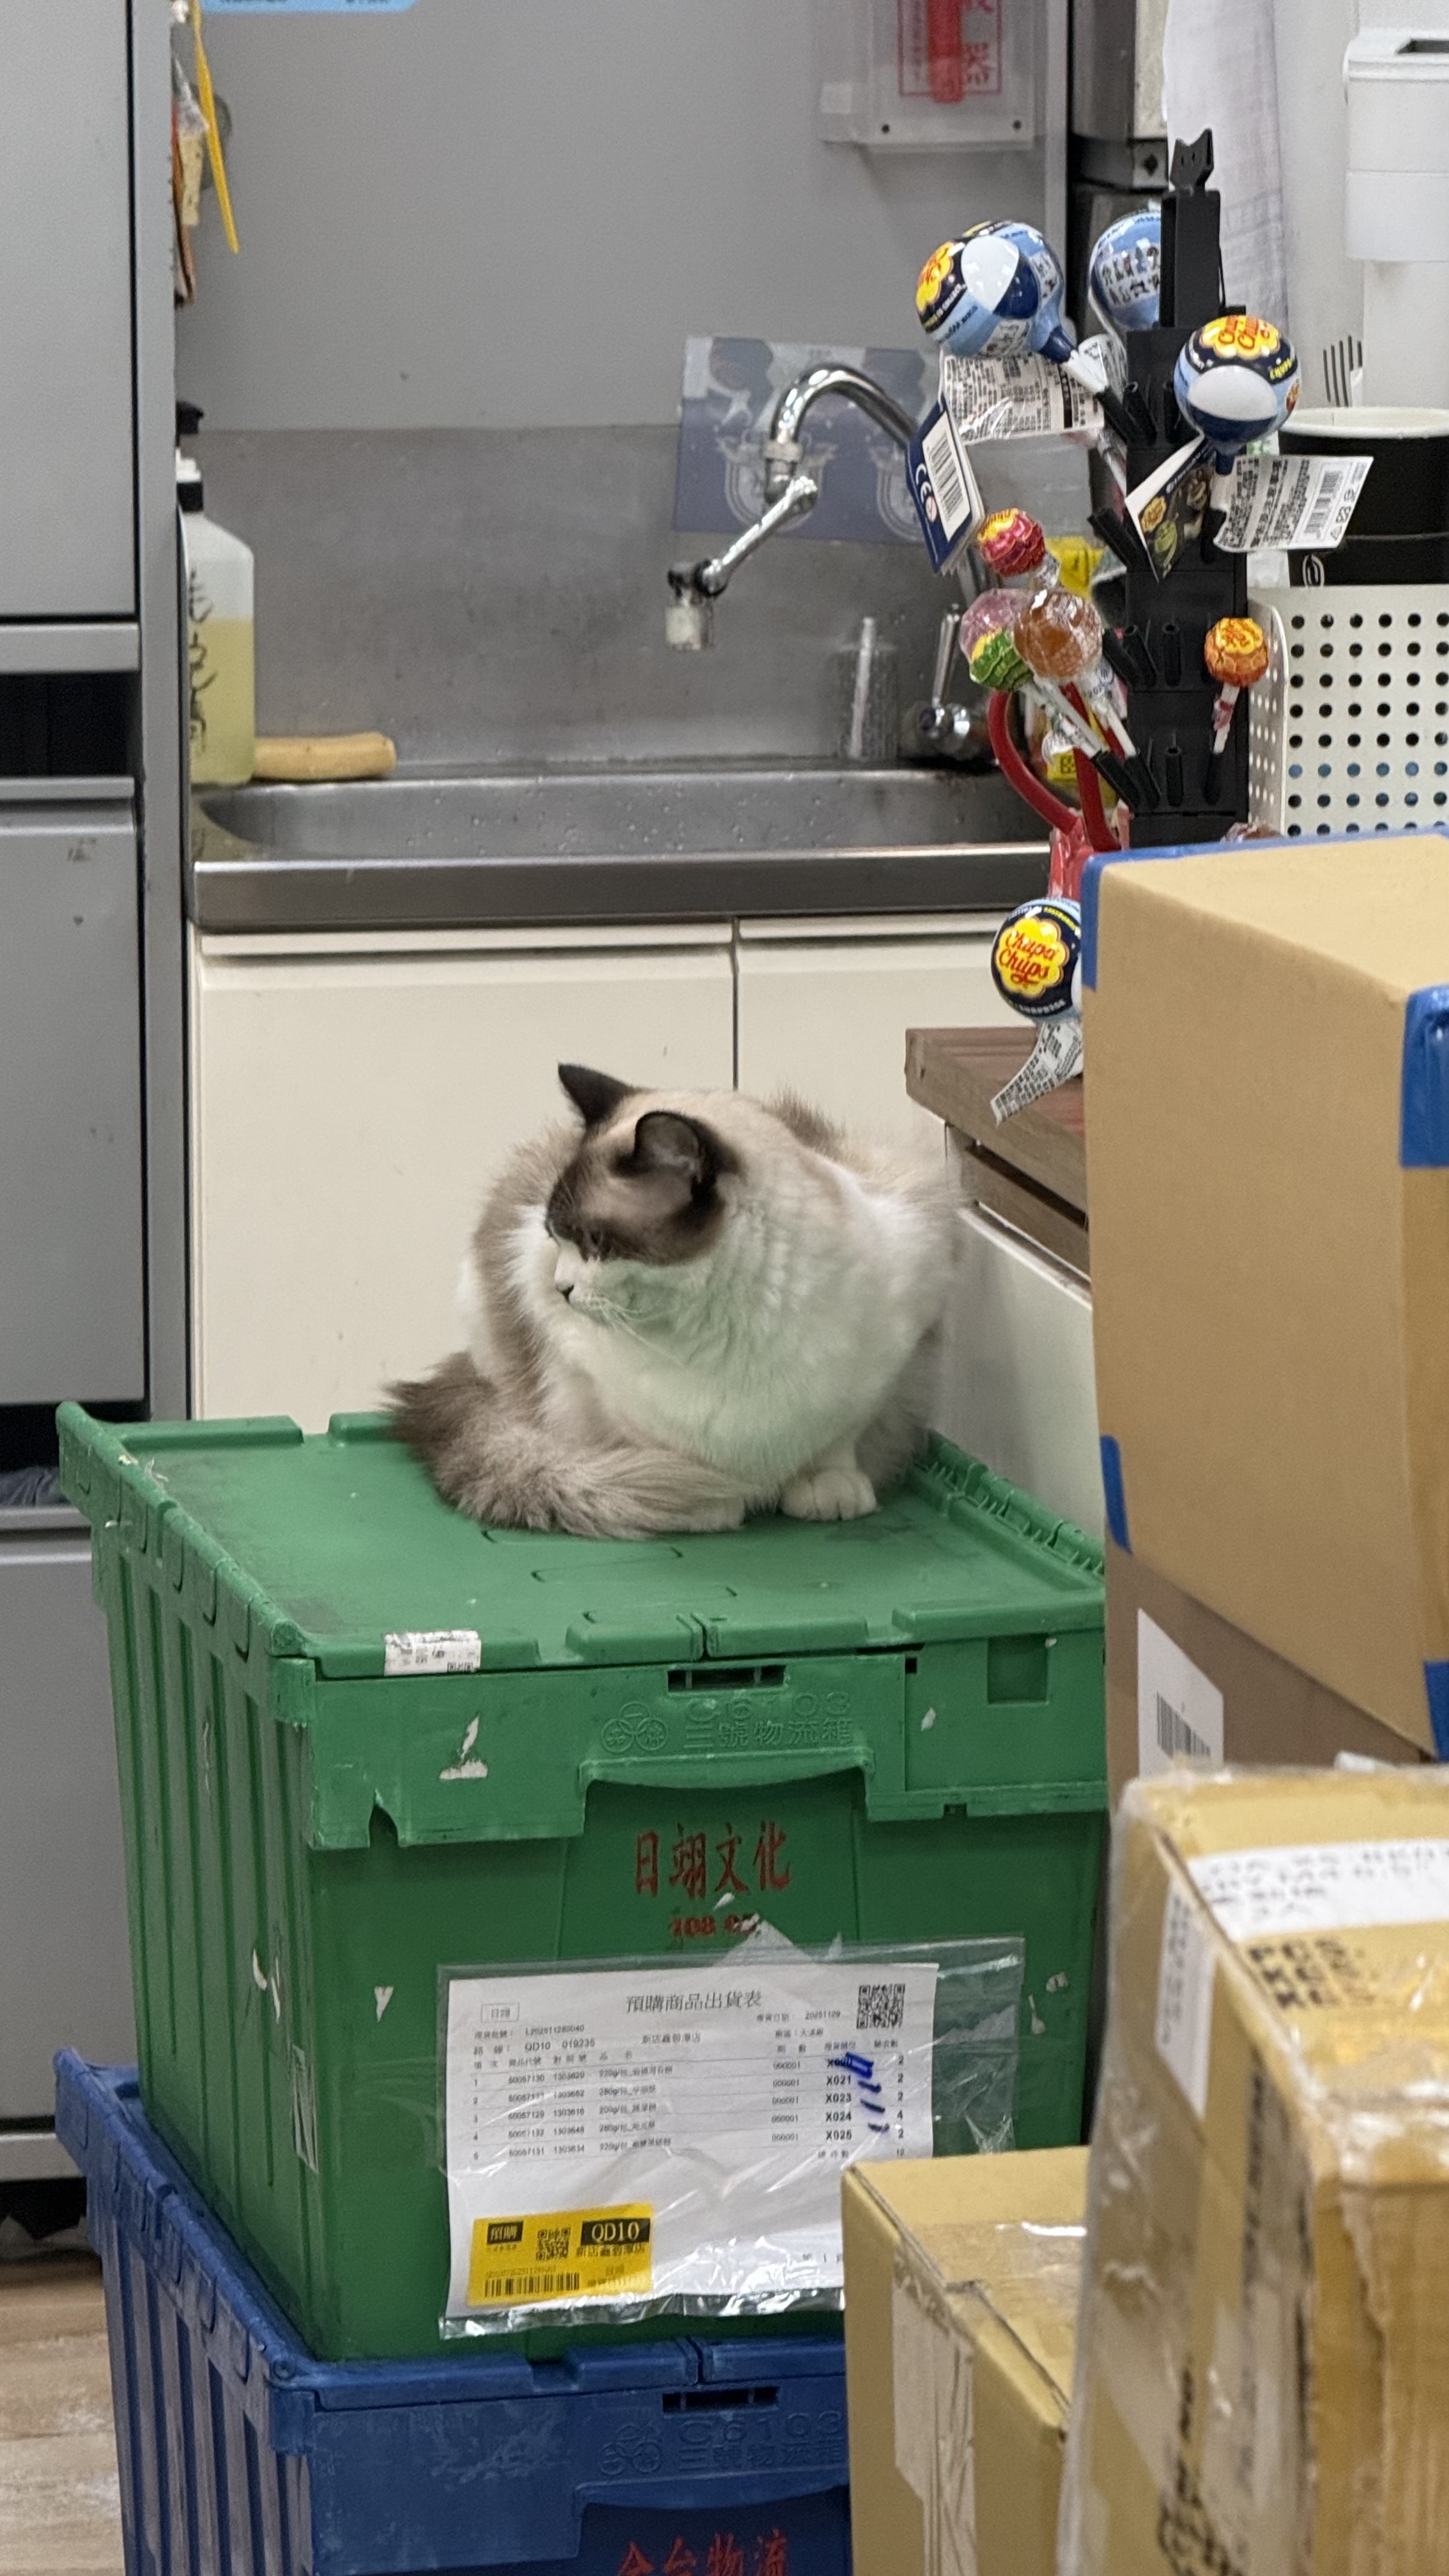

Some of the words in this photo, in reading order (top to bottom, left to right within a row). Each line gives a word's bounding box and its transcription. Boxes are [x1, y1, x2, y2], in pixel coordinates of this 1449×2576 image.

[1005, 930, 1057, 961] Chupa
[999, 949, 1050, 979] Chups
[635, 1821, 792, 1898] 日翊文化
[627, 1990, 761, 2012] 預購商品出貨表
[525, 2041, 551, 2051] QD10
[898, 2055, 904, 2065] 2
[473, 2096, 478, 2105] 2
[827, 2074, 851, 2086] X021
[897, 2073, 903, 2083] 2
[825, 2092, 852, 2104] X023
[897, 2090, 903, 2101] 2
[825, 2111, 852, 2122] X024
[896, 2109, 903, 2120] 4
[826, 2129, 852, 2140] X025
[898, 2128, 903, 2139] 2
[591, 2222, 640, 2244] QD10
